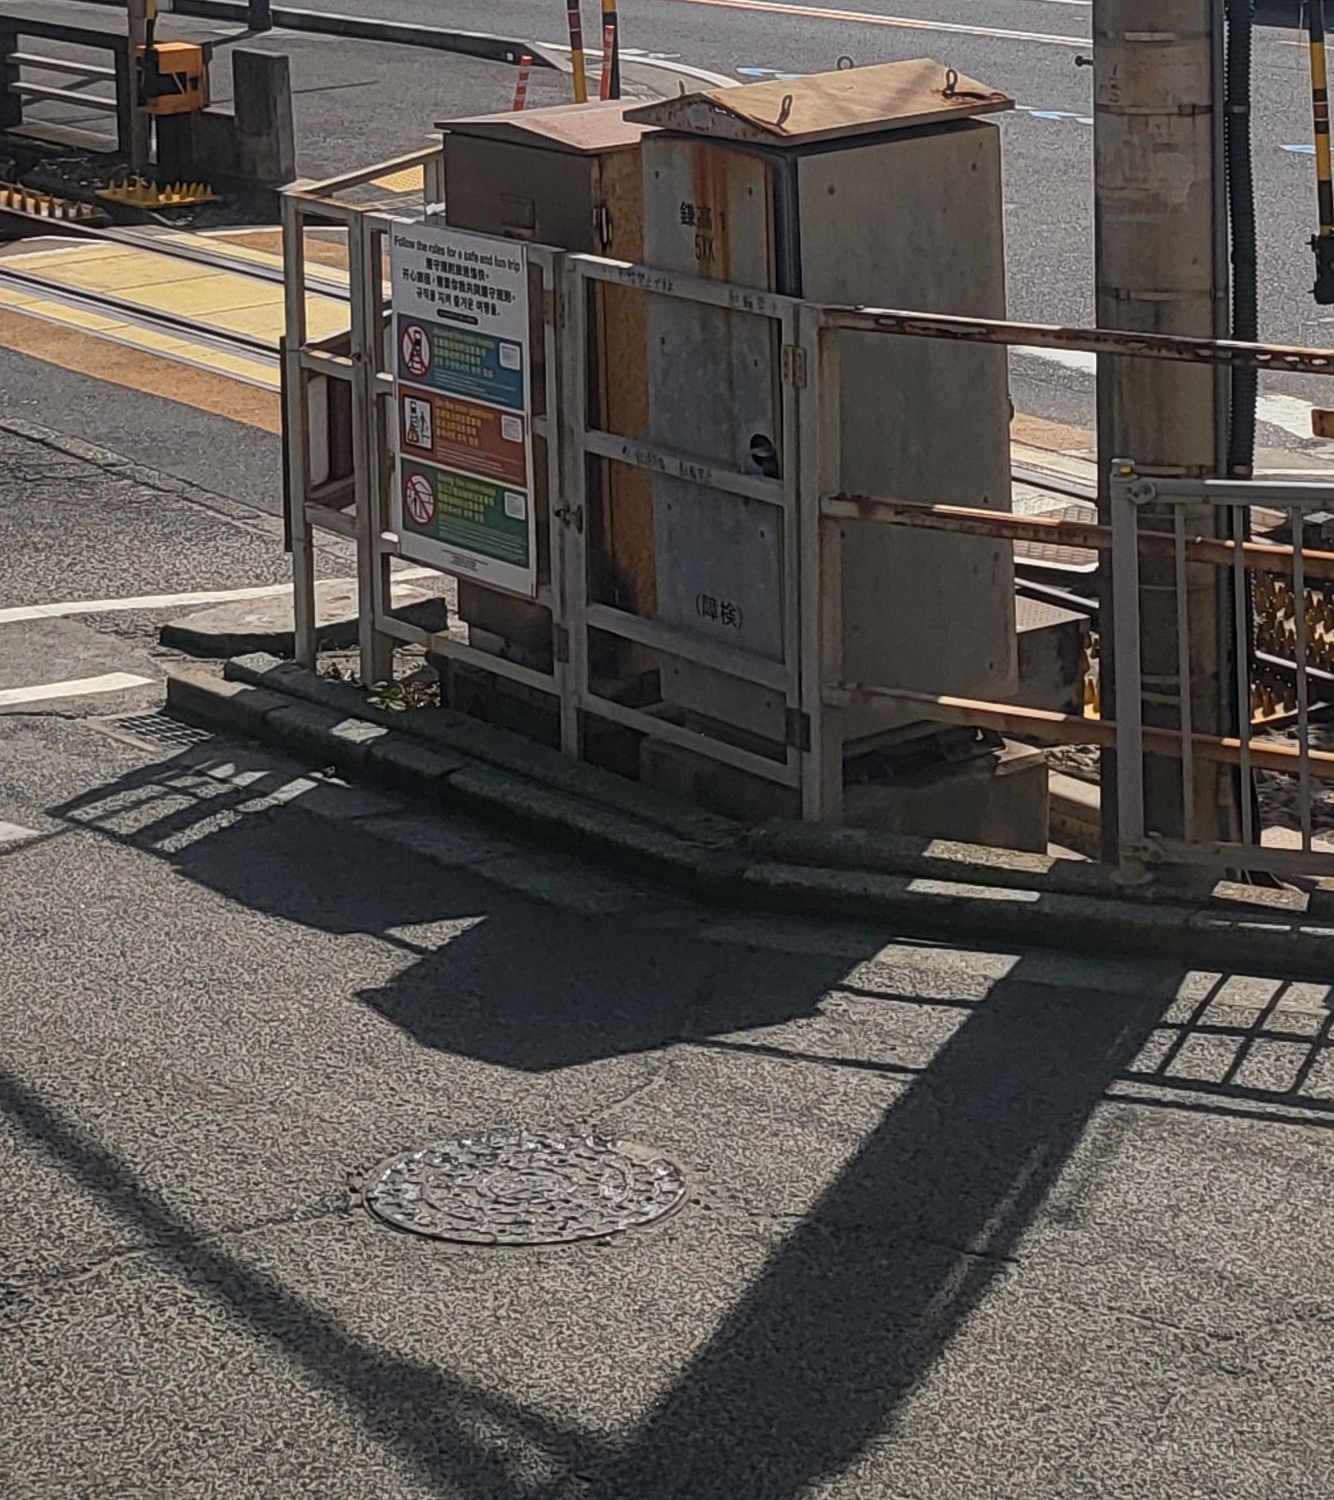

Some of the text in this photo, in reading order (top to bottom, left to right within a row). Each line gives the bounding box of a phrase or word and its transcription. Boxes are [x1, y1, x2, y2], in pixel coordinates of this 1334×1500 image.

[394, 235, 415, 250] Follow
[417, 240, 427, 253] the
[428, 243, 446, 257] rules
[447, 246, 457, 258] for
[464, 250, 479, 264] safe
[480, 254, 493, 266] and
[494, 257, 507, 269] fun
[508, 259, 520, 274] trip
